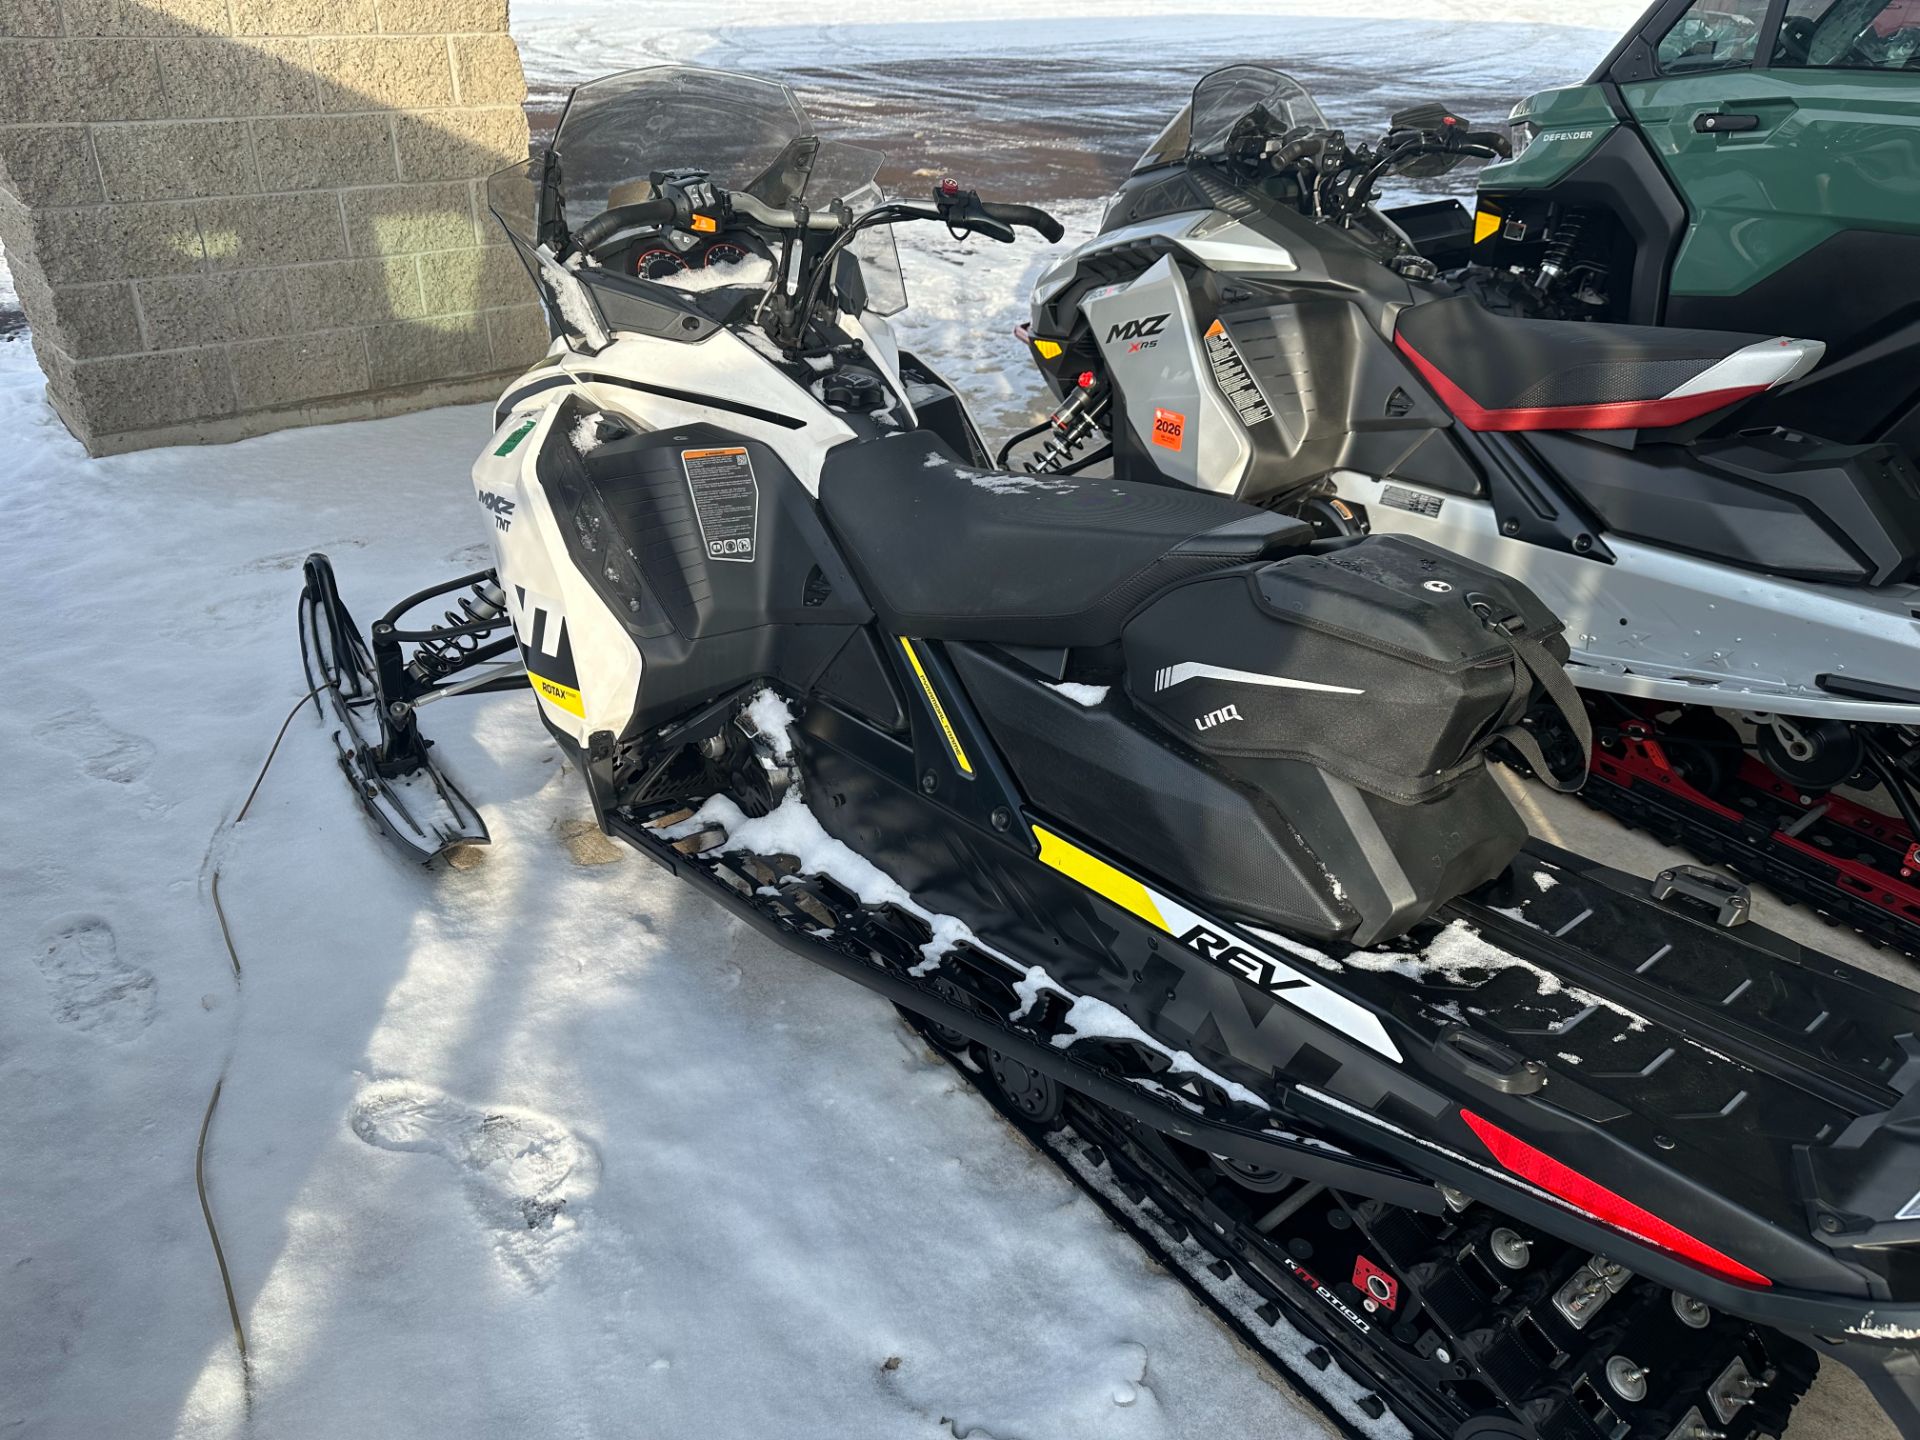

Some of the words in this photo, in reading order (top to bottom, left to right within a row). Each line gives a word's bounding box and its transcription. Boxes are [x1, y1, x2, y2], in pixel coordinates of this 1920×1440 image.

[1543, 131, 1593, 142] DEFENDER
[1105, 312, 1172, 344] MXZ
[1128, 340, 1159, 353] XRS
[1156, 419, 1181, 436] 2026
[478, 489, 516, 515] MXZ
[495, 514, 511, 532] TNT
[542, 682, 566, 699] ROTAX
[1179, 924, 1312, 991] REV
